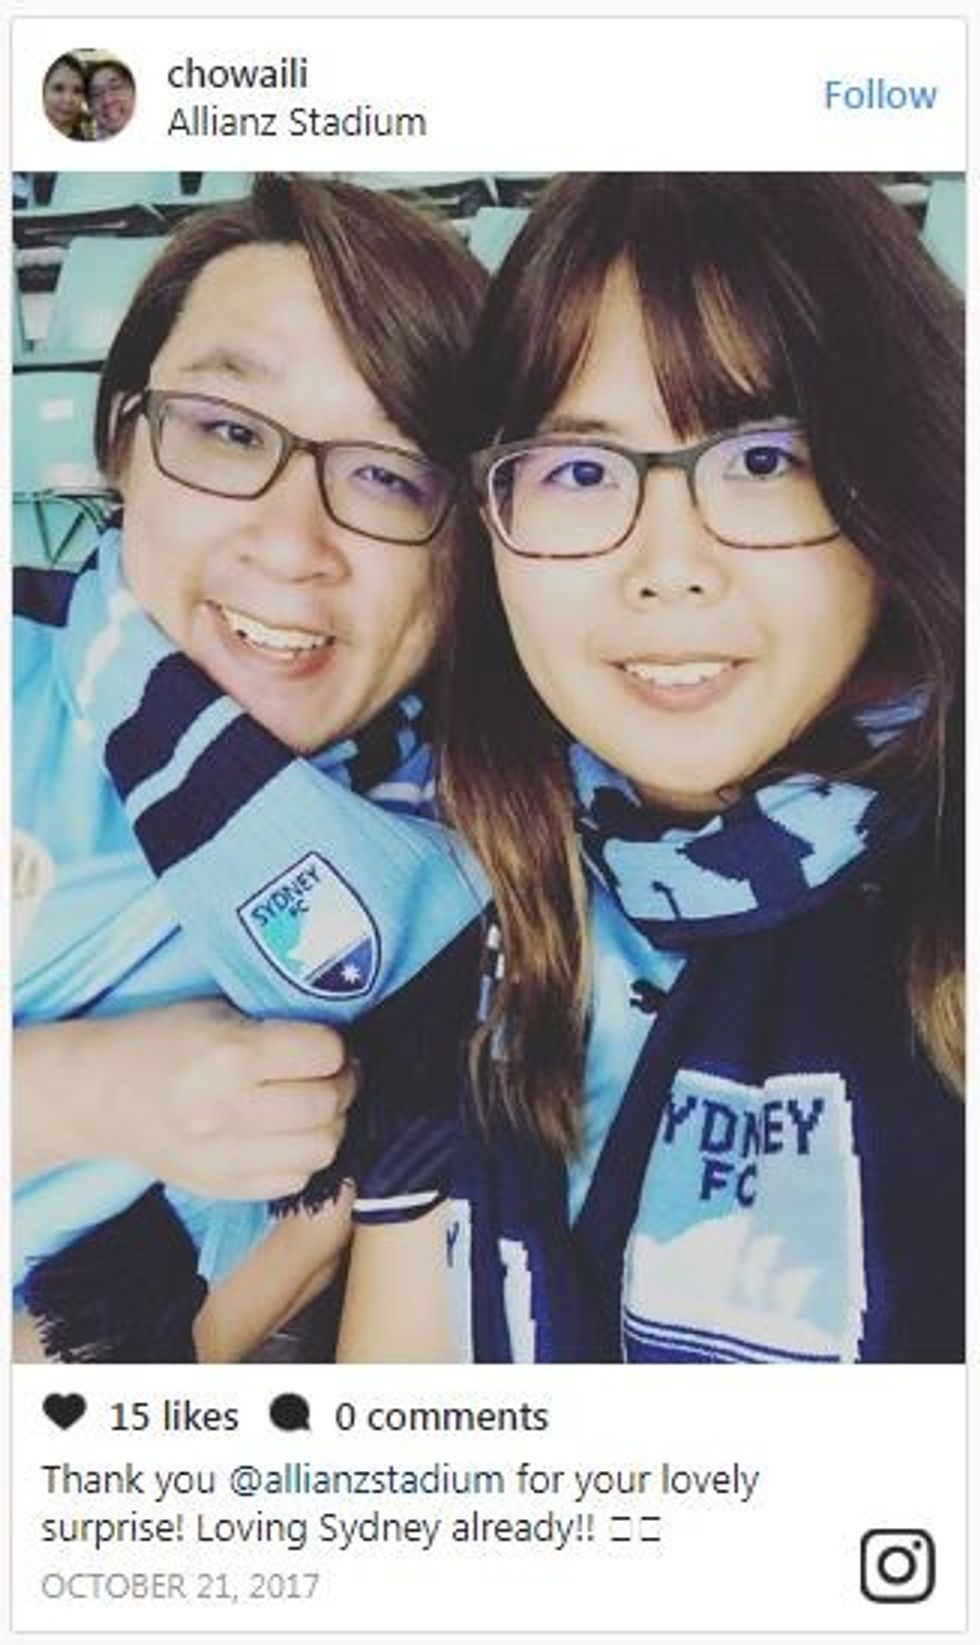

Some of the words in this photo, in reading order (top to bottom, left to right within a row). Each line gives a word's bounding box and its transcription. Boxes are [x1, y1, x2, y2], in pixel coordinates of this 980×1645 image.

[252, 865, 321, 927] SYDNEY
[664, 1097, 825, 1157] YDNEY
[701, 1158, 757, 1206] FC
